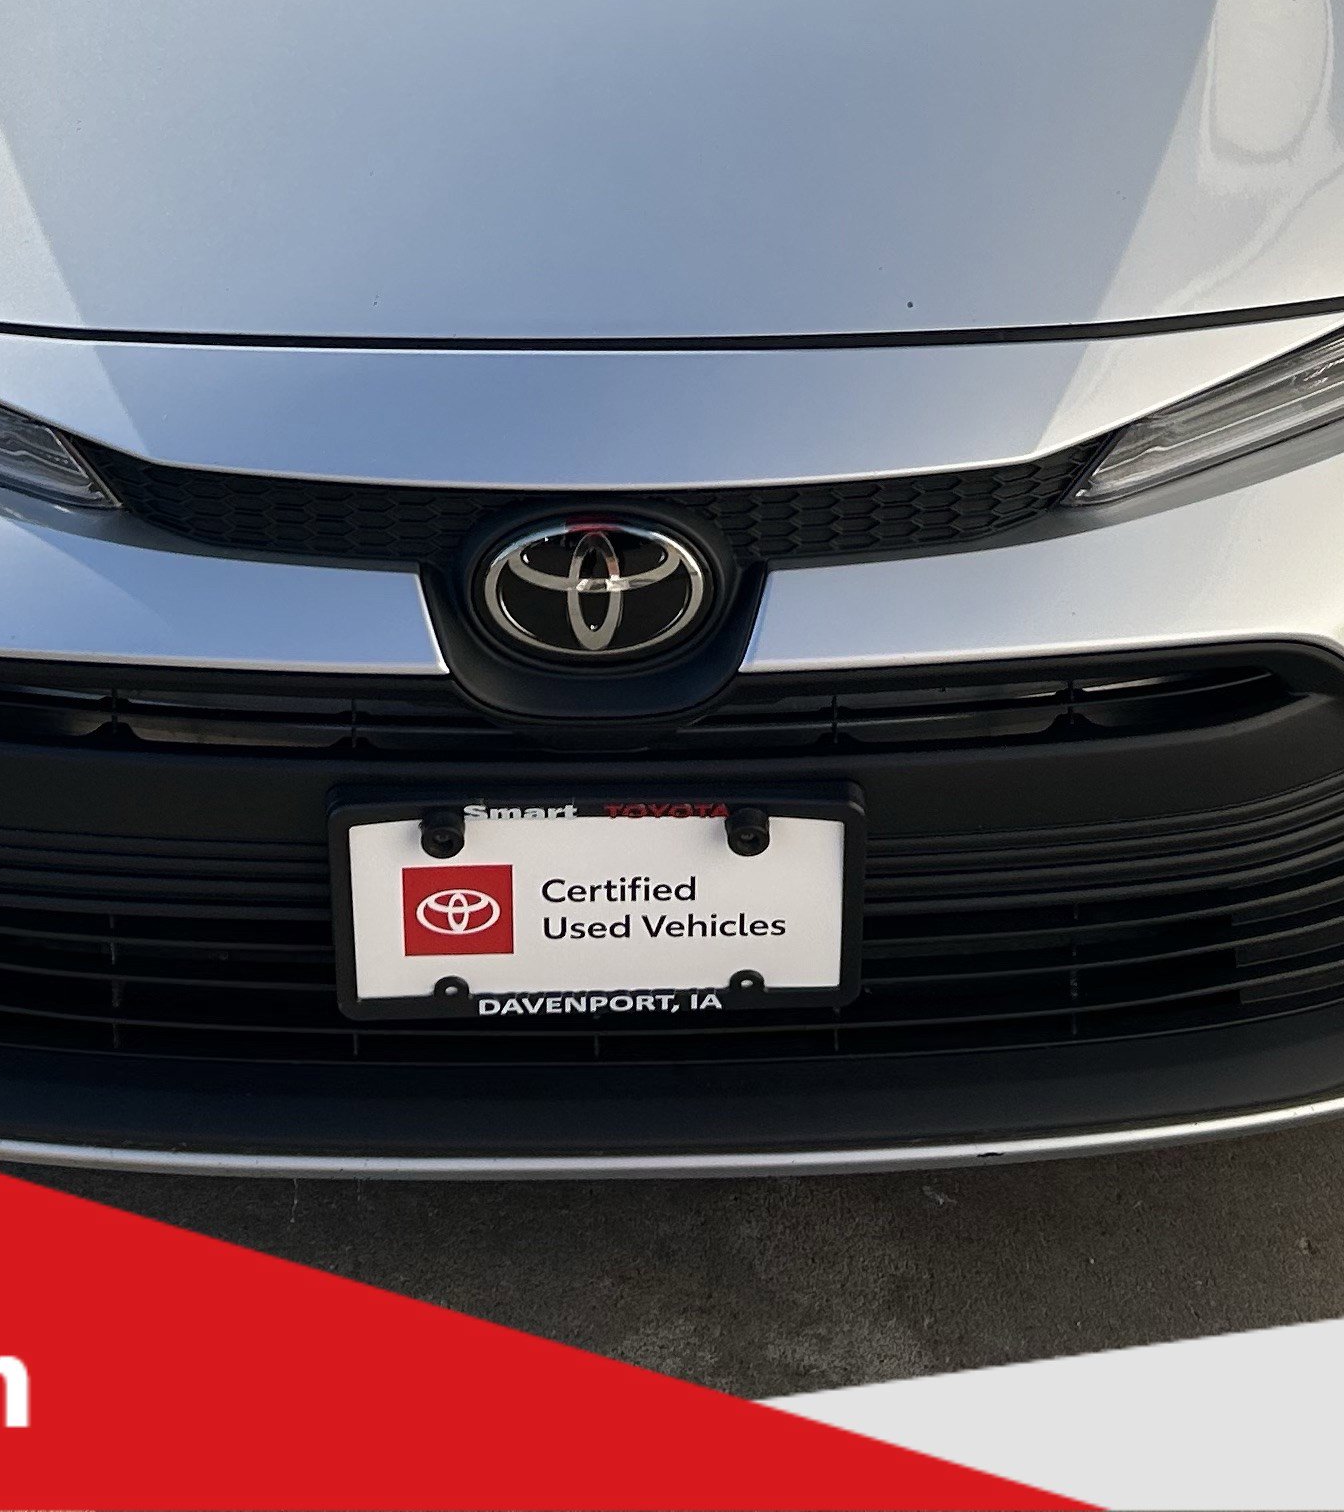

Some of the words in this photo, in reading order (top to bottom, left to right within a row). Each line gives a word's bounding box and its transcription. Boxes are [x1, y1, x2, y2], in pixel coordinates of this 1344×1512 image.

[463, 804, 578, 819] Smart
[604, 803, 731, 818] TOYOTA
[542, 876, 697, 903] Certified
[543, 915, 631, 940] Used
[641, 912, 786, 938] Vehicles
[478, 994, 680, 1016] DAVENPORT,
[690, 994, 722, 1010] IA
